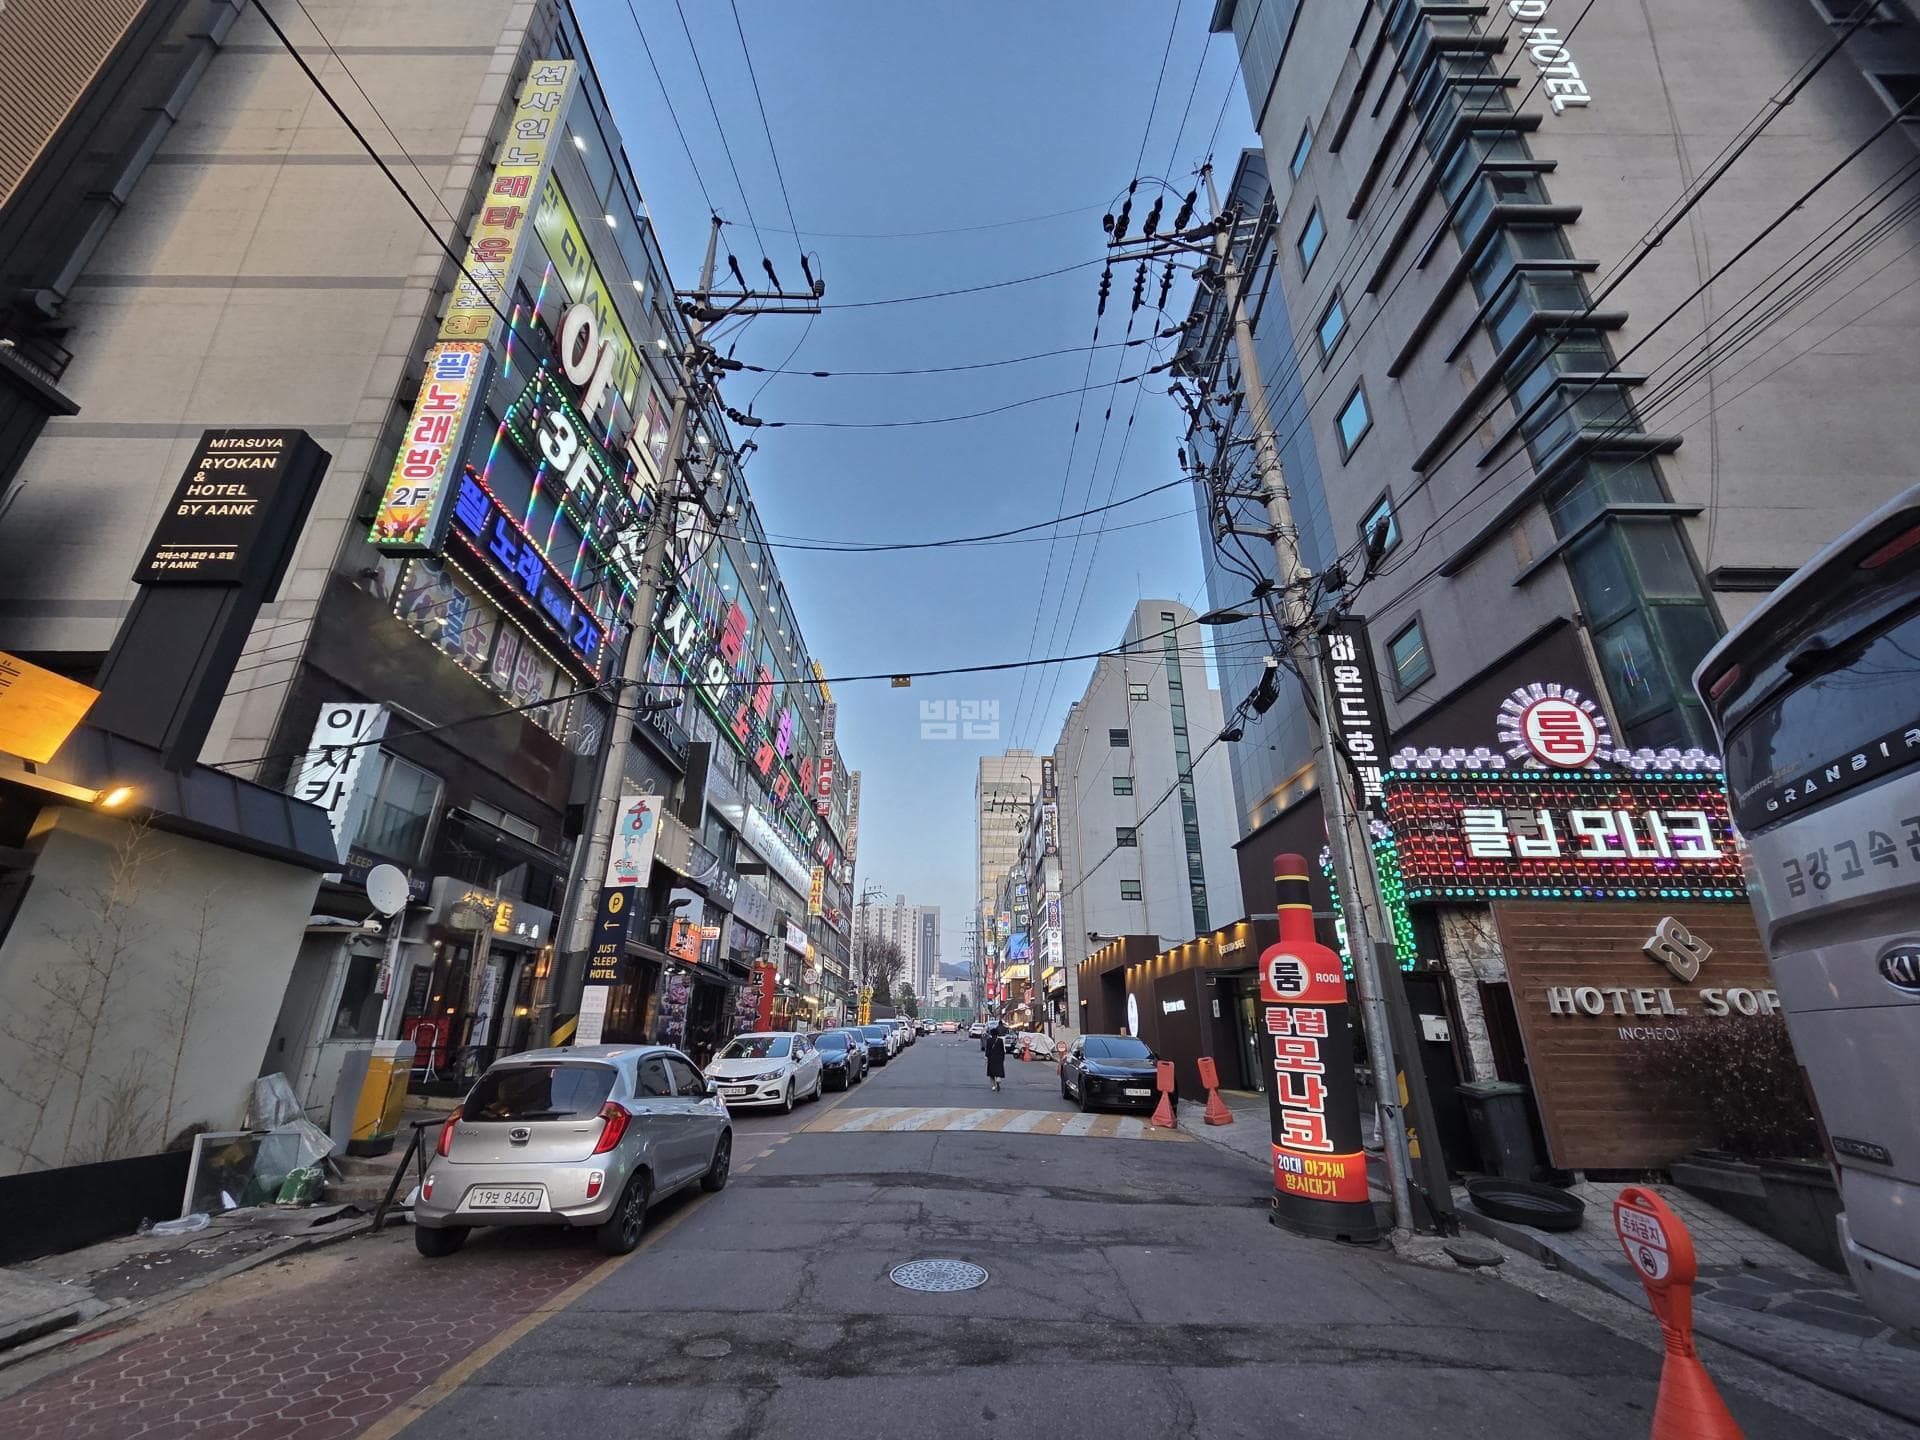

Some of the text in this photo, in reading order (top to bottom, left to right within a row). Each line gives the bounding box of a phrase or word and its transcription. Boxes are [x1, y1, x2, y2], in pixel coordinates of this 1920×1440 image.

[1520, 27, 1592, 113] HOTEL
[444, 315, 490, 335] 3F
[209, 438, 284, 448] MITASUYA
[538, 411, 603, 495] 3F
[199, 458, 277, 469] RYOKAN
[193, 472, 206, 482] &
[186, 485, 247, 496] HOTEL
[391, 486, 430, 508] 2F
[177, 505, 256, 516] BY AANK
[151, 561, 199, 569] BY AANK
[573, 615, 600, 655] 2F
[653, 710, 675, 744] BAR
[1535, 710, 1587, 754] 룸
[818, 758, 834, 796] PC
[817, 801, 829, 811] 3F
[1461, 808, 1723, 859] 클럽 모나코
[597, 944, 617, 954] JUST
[592, 956, 618, 967] SLEEP
[1885, 953, 1920, 982] KI
[589, 968, 617, 979] HOTEL
[1273, 962, 1303, 992] 룸
[1315, 972, 1341, 984] ROOM
[1546, 986, 1688, 1016] HOTEL
[1265, 1006, 1335, 1153] 클럽 모나코
[1277, 1154, 1345, 1179] 20대 아가씨
[1285, 1174, 1338, 1198] 항시대기
[503, 1191, 535, 1205] 8460
[1622, 1215, 1661, 1245] 주차금지
